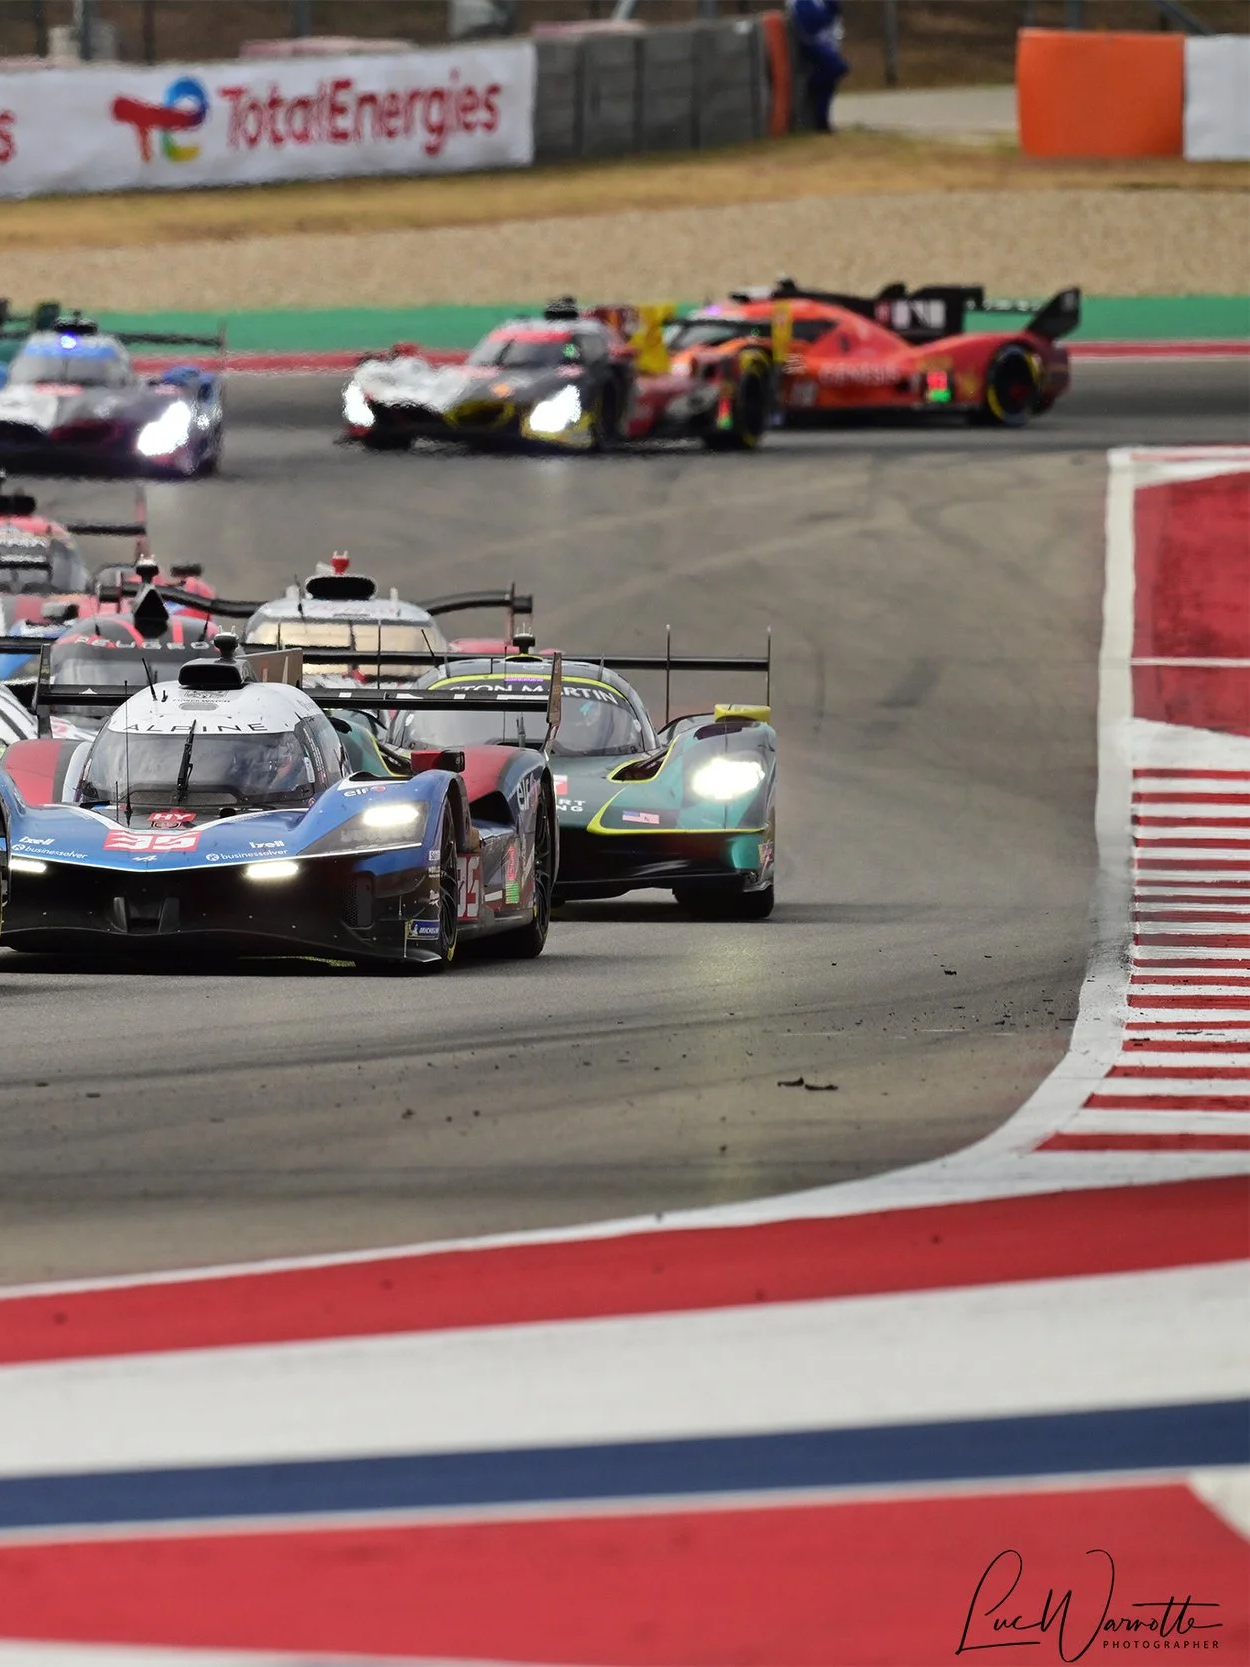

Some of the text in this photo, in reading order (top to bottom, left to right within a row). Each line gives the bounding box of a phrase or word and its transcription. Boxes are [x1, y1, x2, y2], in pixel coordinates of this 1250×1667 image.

[218, 67, 501, 158] TotalEnergies
[76, 636, 214, 649] PEUGEO
[522, 685, 619, 705] MRTIN
[123, 722, 269, 732] ALPINE
[154, 813, 191, 821] HY
[106, 830, 197, 850] 35
[25, 845, 88, 859] businessolver
[220, 849, 289, 860] businessolver
